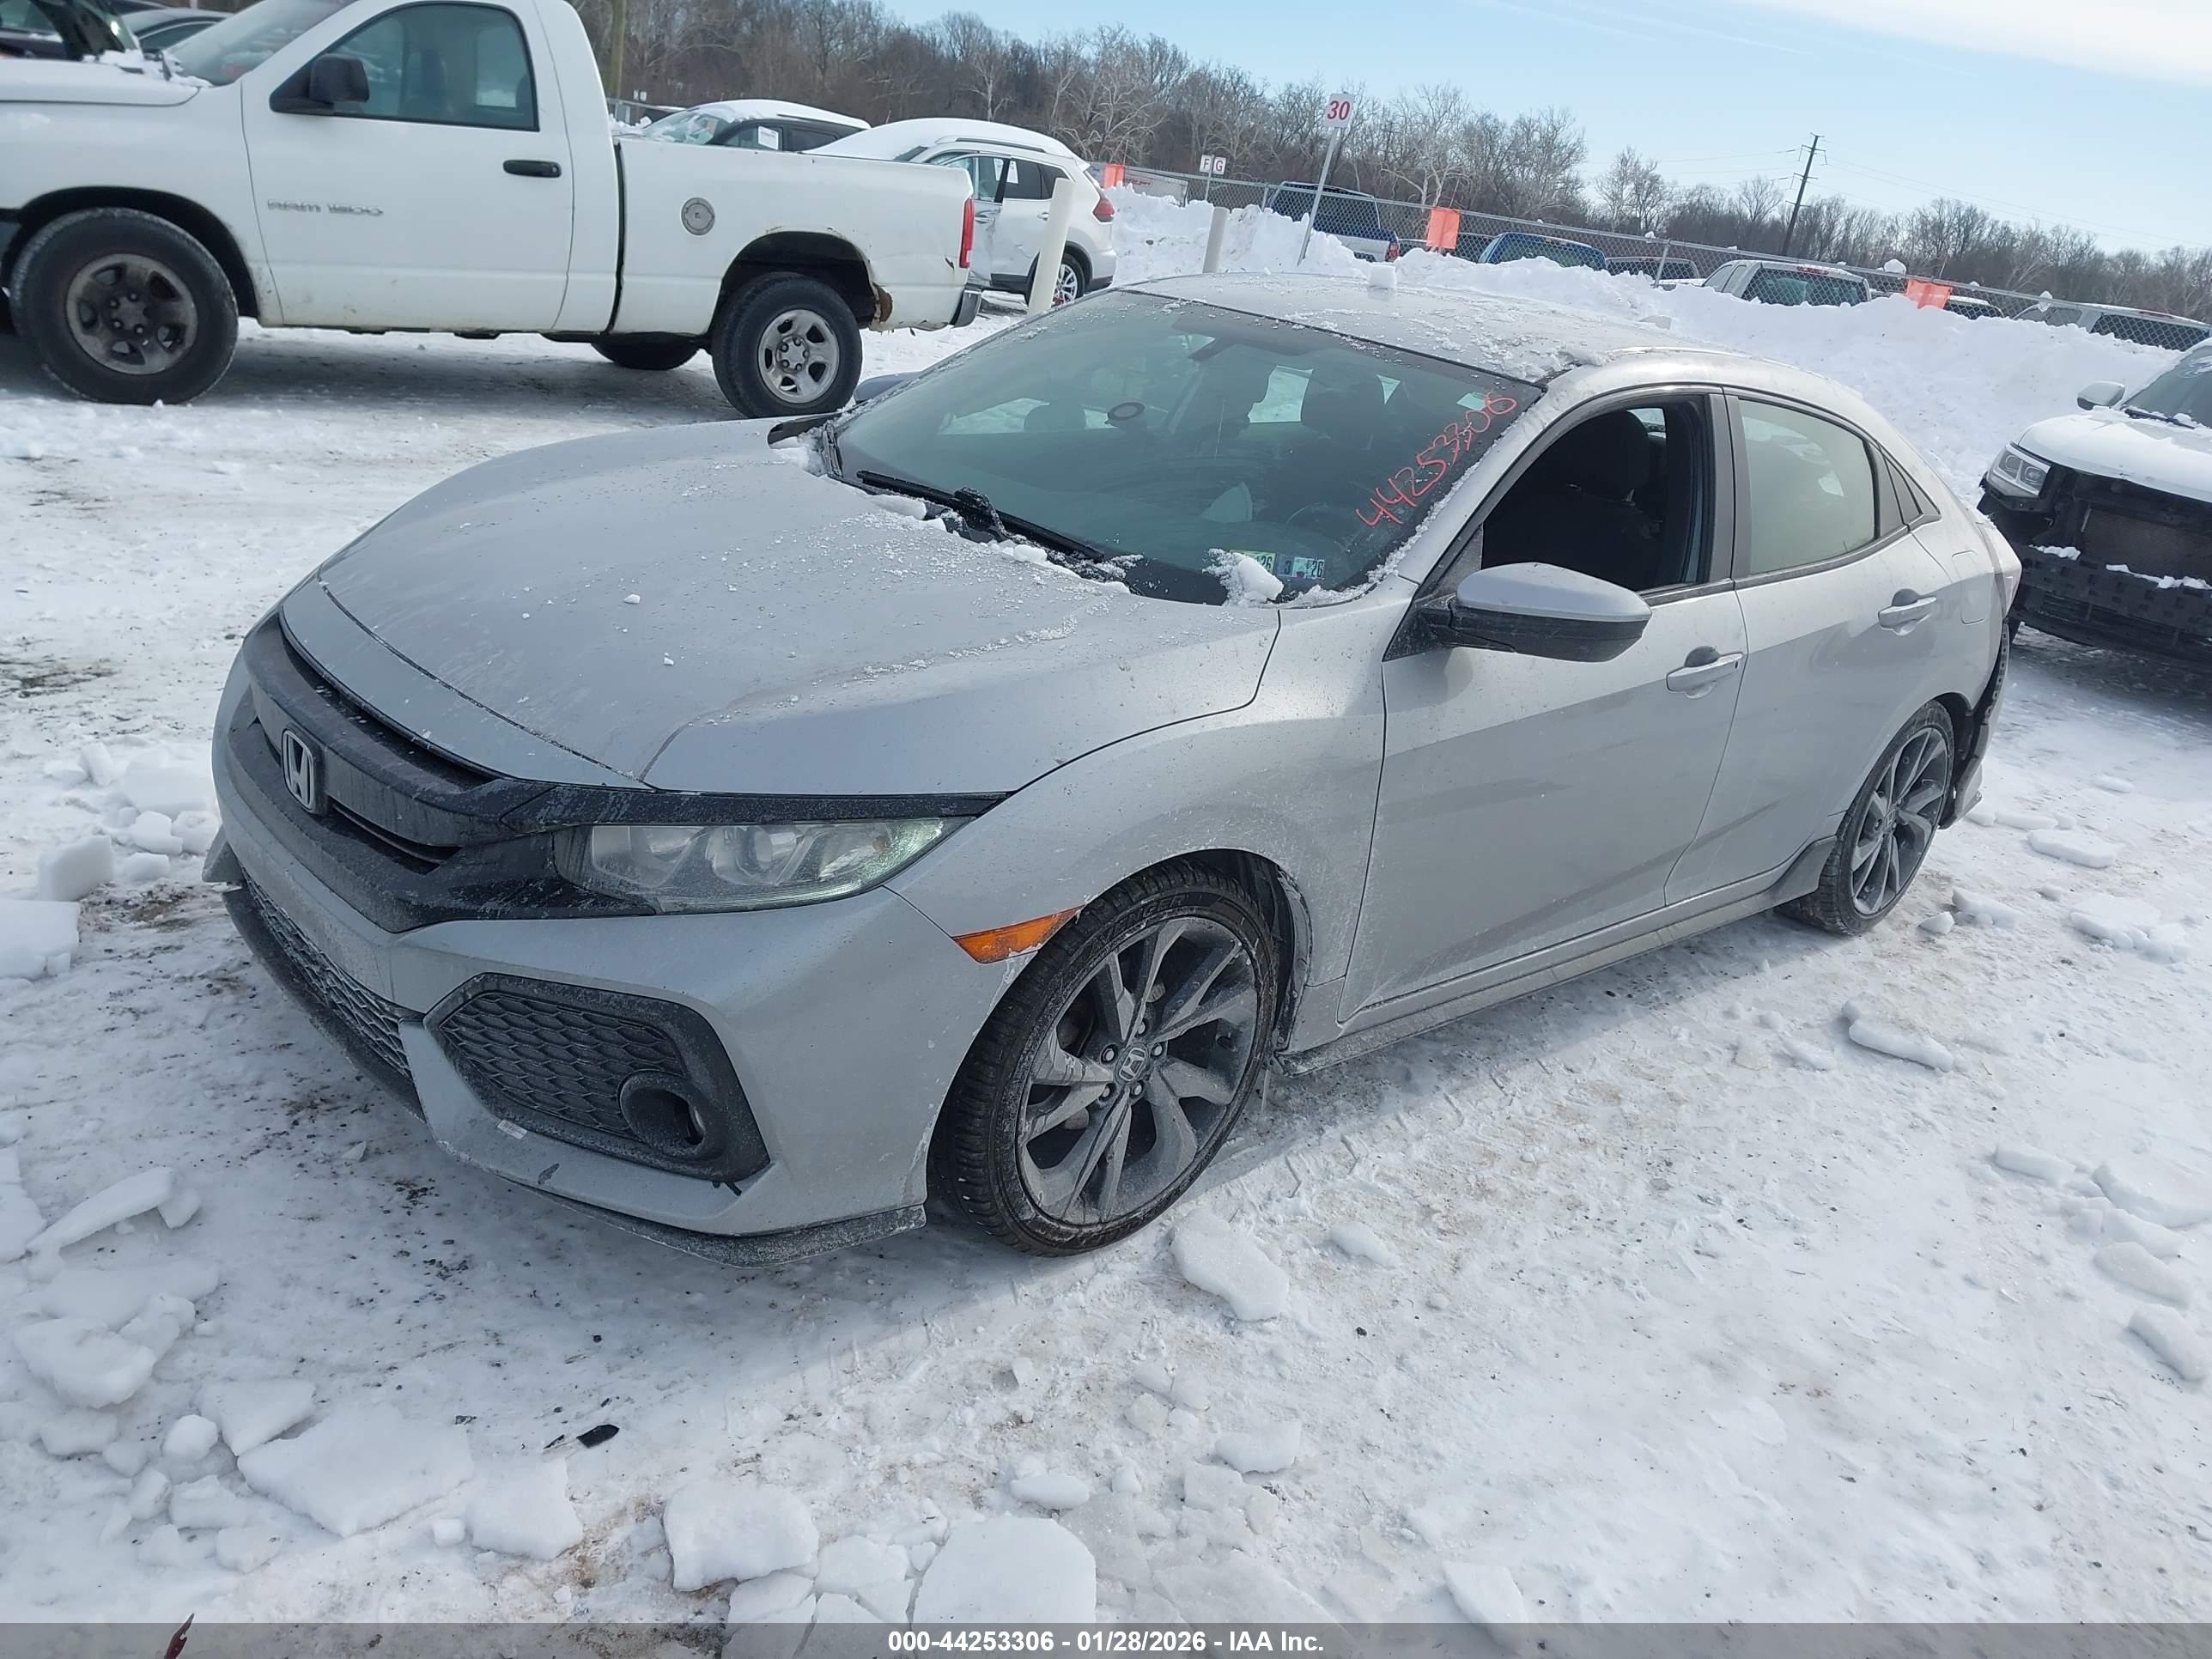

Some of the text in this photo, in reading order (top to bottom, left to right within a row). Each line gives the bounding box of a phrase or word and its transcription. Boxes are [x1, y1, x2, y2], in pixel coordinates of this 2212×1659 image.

[1327, 100, 1351, 120] 30
[1203, 158, 1223, 172] F G
[1356, 392, 1517, 527] 44253306
